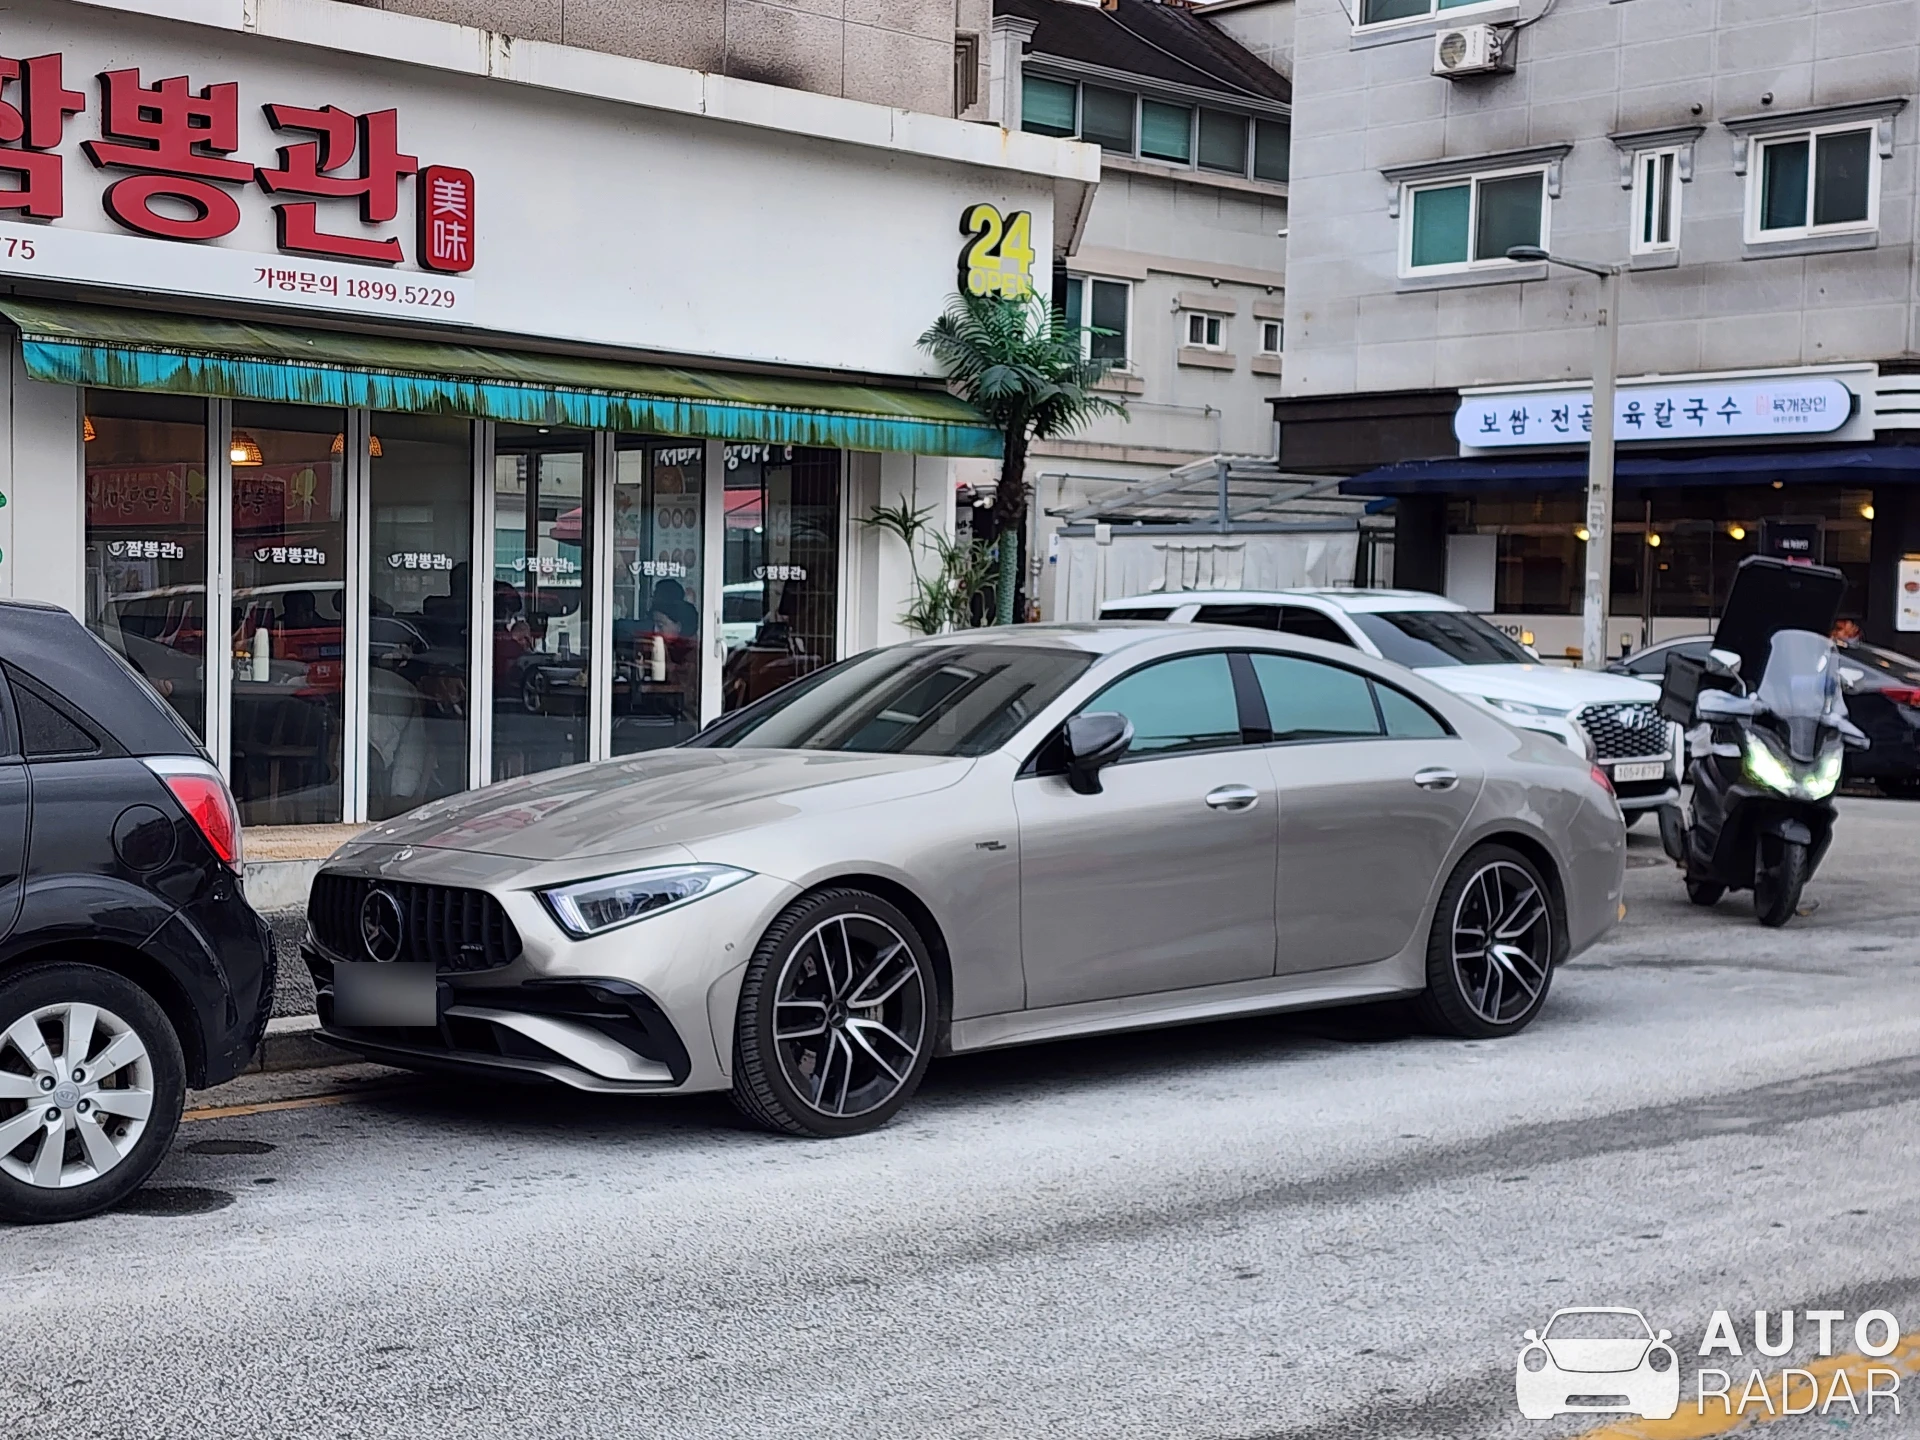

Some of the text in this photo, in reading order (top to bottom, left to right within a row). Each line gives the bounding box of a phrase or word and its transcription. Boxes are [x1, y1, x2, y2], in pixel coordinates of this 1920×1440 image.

[432, 177, 467, 262] 美味
[966, 204, 1035, 275] 24
[254, 268, 455, 308] 가맹문의 1899.5229
[968, 268, 1032, 302] OPEN
[125, 540, 177, 558] 짬뽕관
[271, 547, 319, 565] 짬뽕관
[403, 552, 446, 570] 짬뽕관
[527, 557, 567, 573] 짬뽕관
[643, 560, 681, 577] 짬뽕관
